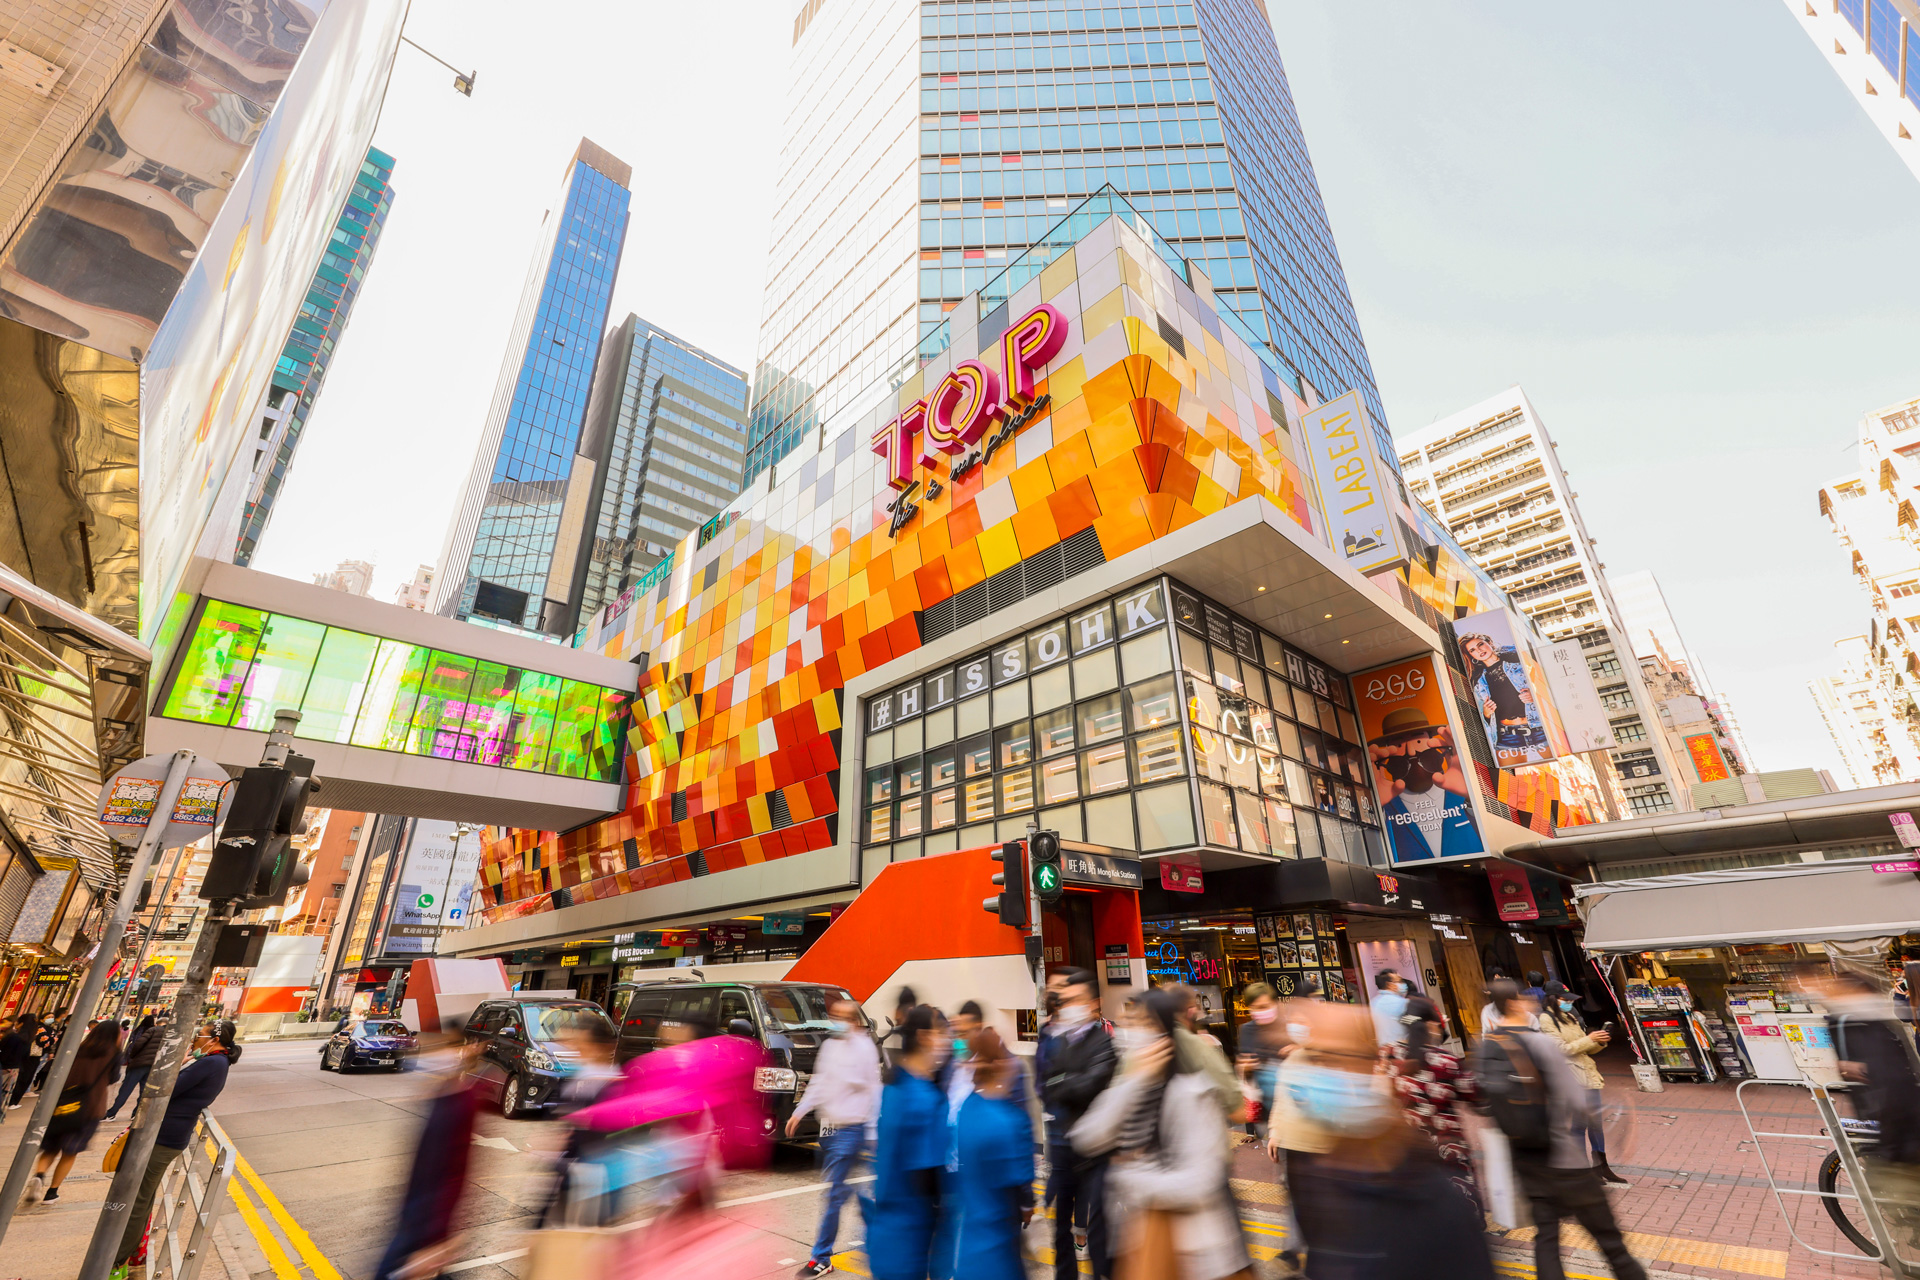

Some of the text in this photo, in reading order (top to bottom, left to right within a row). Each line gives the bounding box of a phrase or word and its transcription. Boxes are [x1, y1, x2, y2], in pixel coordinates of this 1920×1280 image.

[982, 393, 1053, 466] place
[1321, 407, 1375, 516] LABEAT
[1553, 649, 1576, 678] 樓上
[1497, 743, 1547, 760] GUESS
[1414, 800, 1436, 810] FEEL
[103, 814, 149, 824] 9862 4044
[173, 812, 215, 823] 9862 4044
[1419, 822, 1443, 833] TODAY
[1068, 859, 1097, 875] 旺角站
[1097, 867, 1137, 880] Mong Kok Station
[404, 911, 441, 920] WhatsApp
[618, 948, 655, 957] YVES ROCHER
[1147, 966, 1181, 975] onnected
